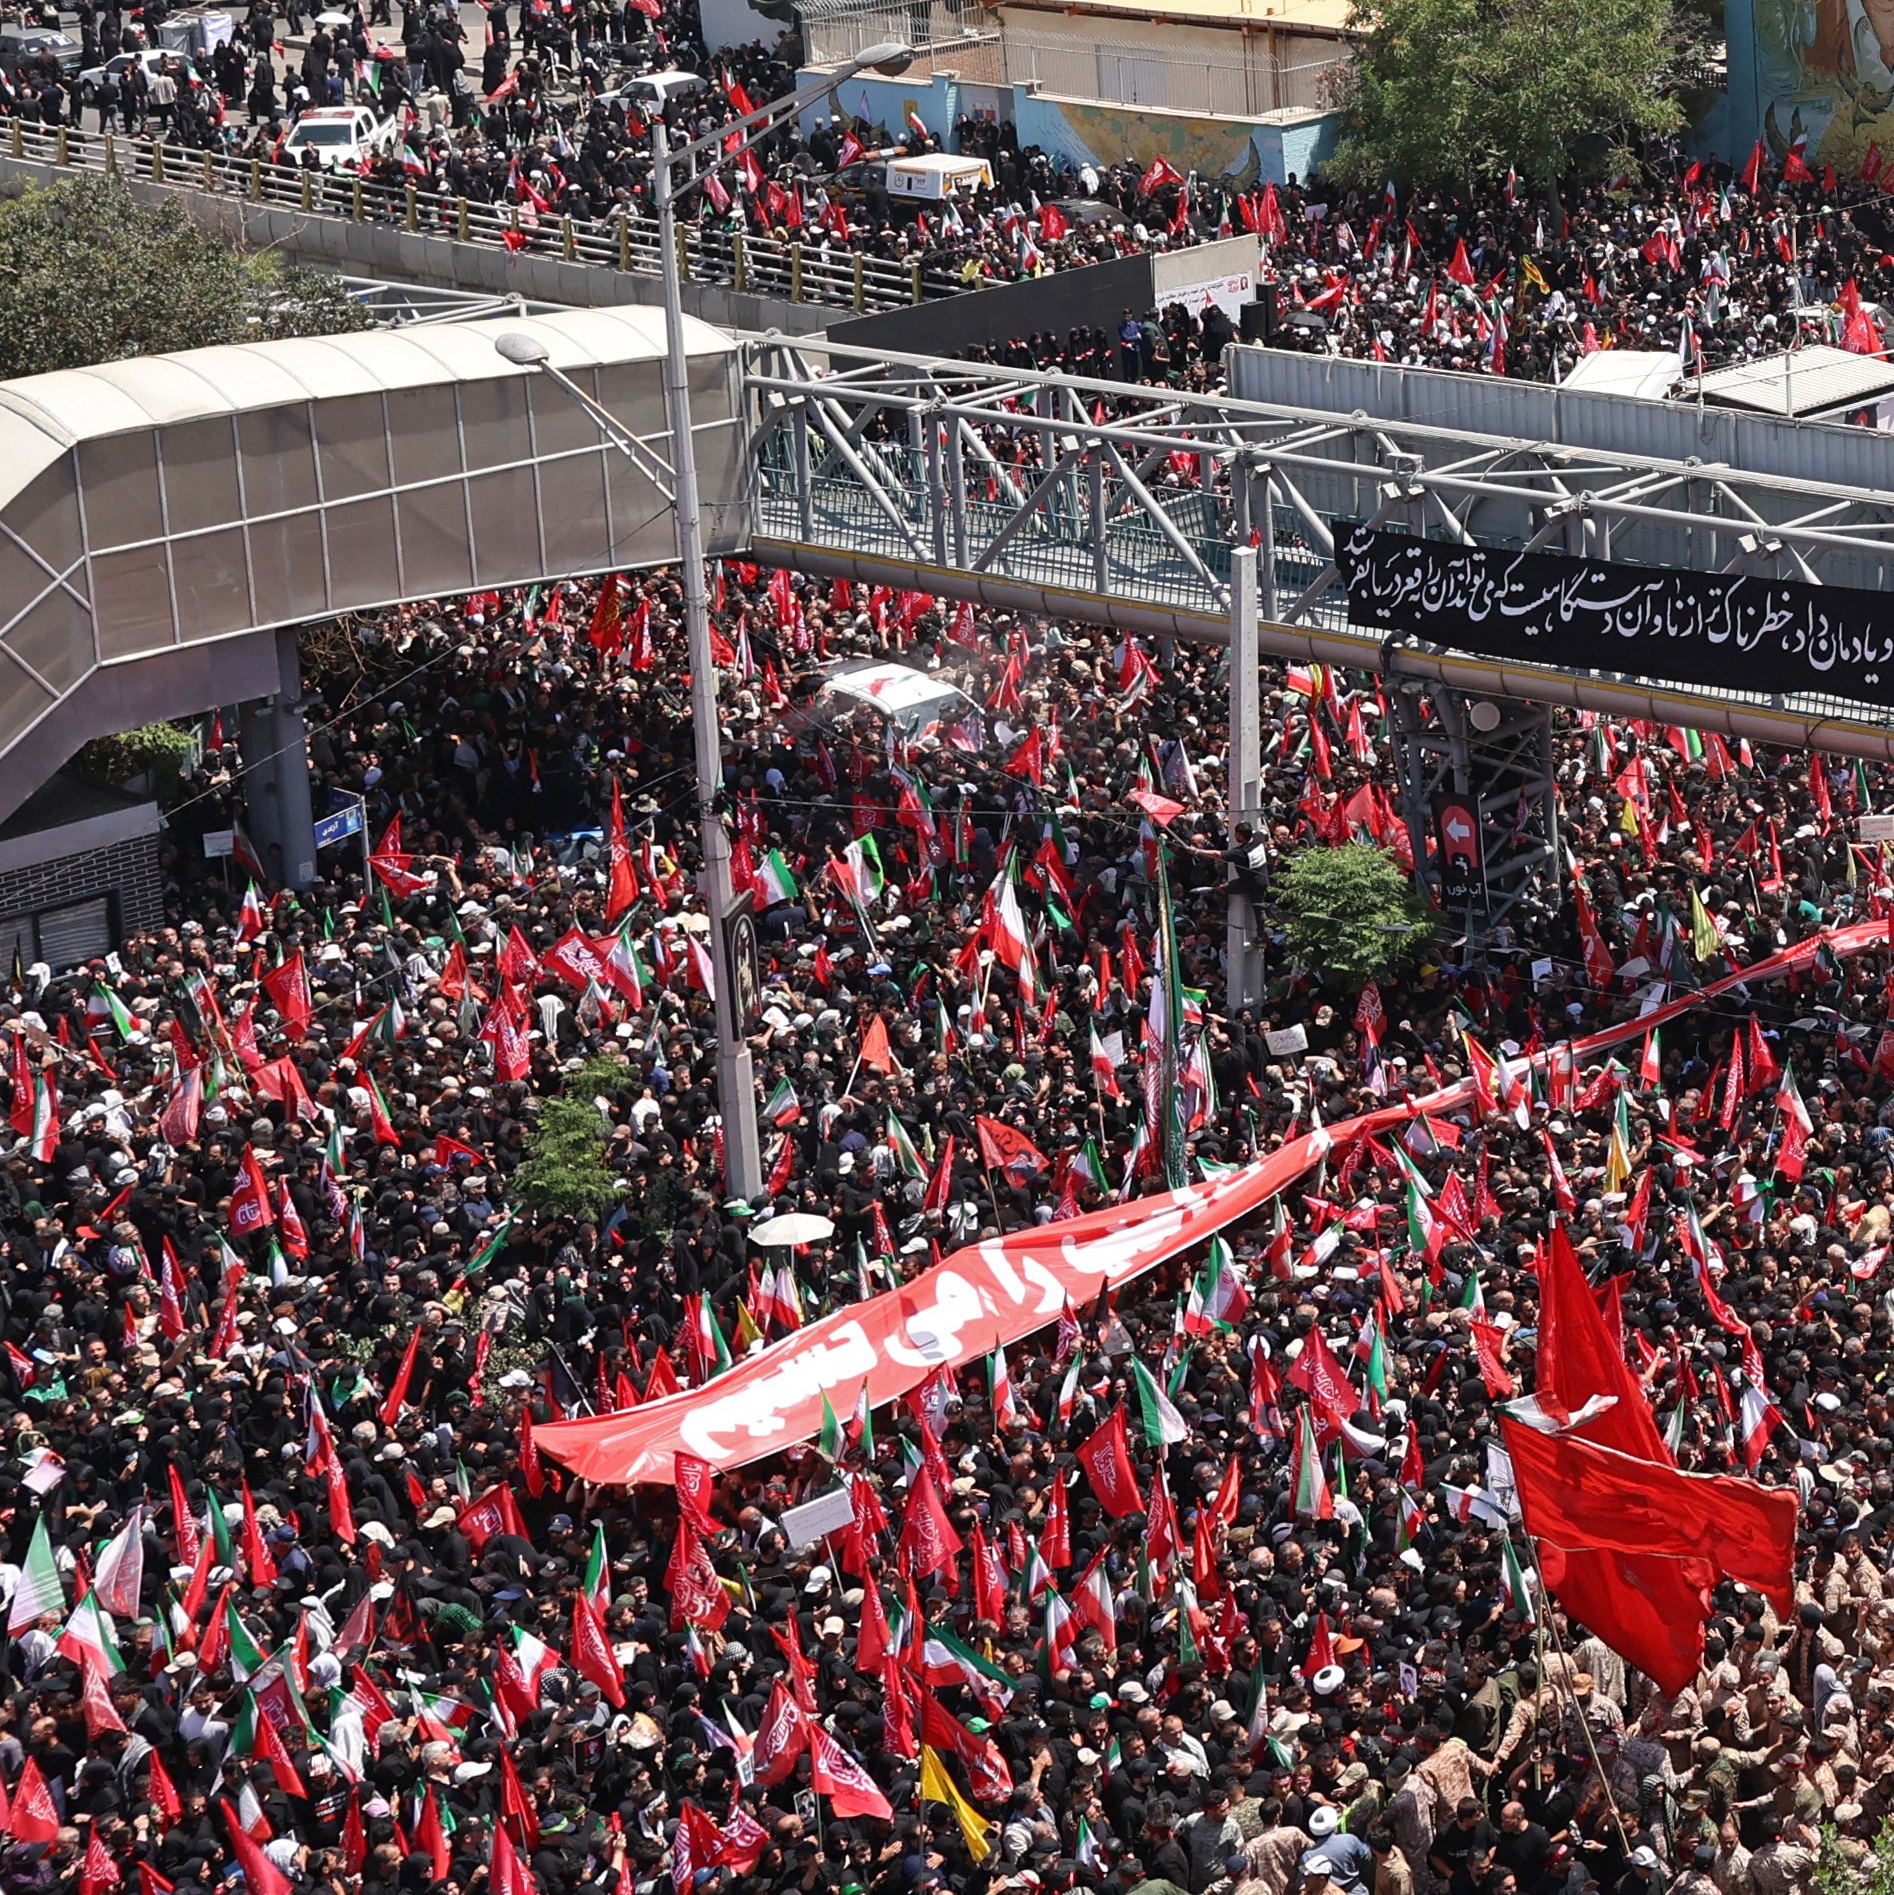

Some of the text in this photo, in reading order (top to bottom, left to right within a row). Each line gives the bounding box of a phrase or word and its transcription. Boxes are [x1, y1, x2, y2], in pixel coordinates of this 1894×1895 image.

[1494, 552, 1525, 599] که
[1680, 594, 1703, 639] از
[1469, 883, 1483, 898] آب
